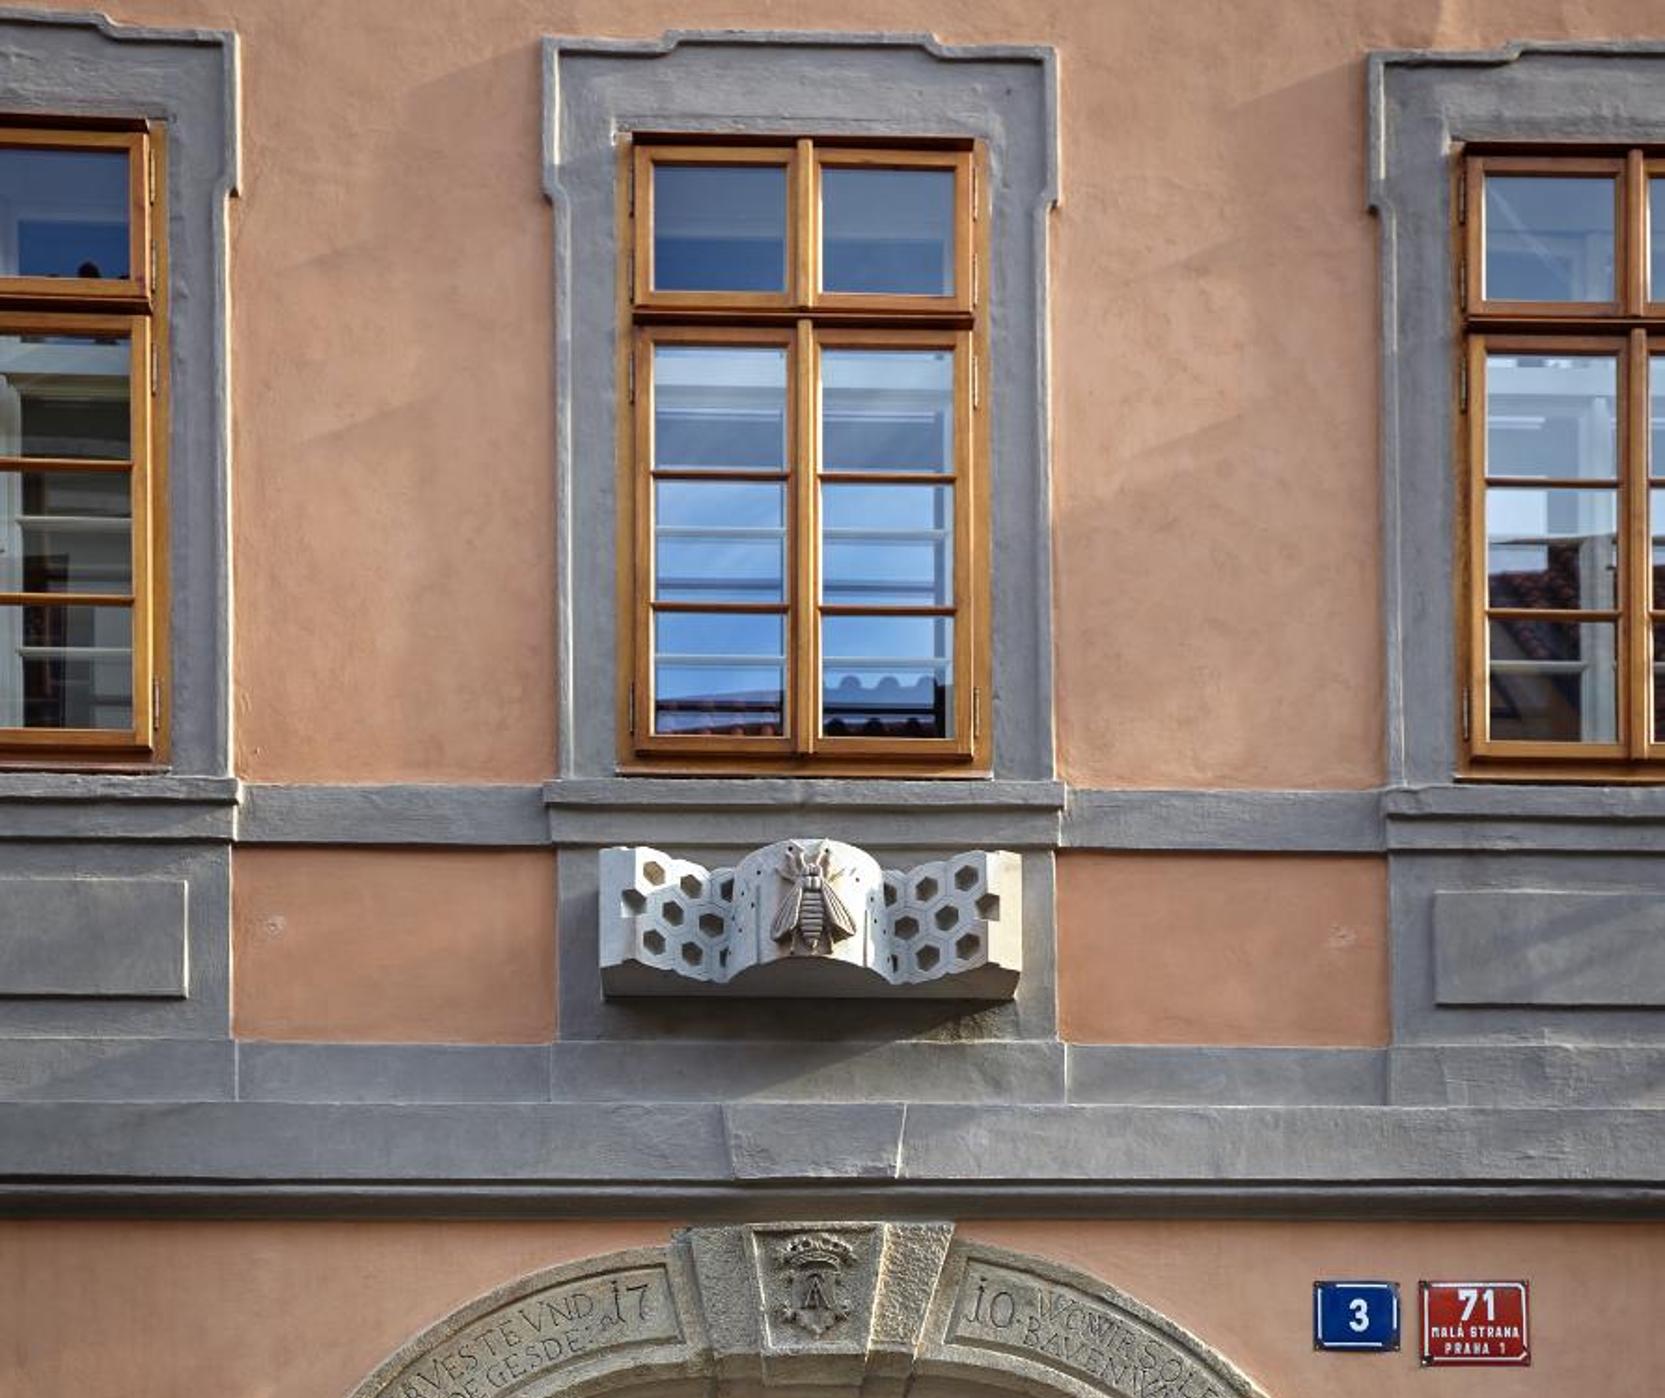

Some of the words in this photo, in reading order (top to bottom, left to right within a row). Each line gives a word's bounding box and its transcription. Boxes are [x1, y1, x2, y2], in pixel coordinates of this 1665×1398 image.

[1349, 1298, 1370, 1332] 3
[1458, 1289, 1495, 1321] 71
[414, 1313, 522, 1397] VESTE
[515, 1285, 596, 1338] VND
[1431, 1323, 1464, 1338] MALÁ
[1470, 1327, 1520, 1338] STRANA
[1444, 1342, 1490, 1355] PRAHA
[1500, 1342, 1506, 1355] 1
